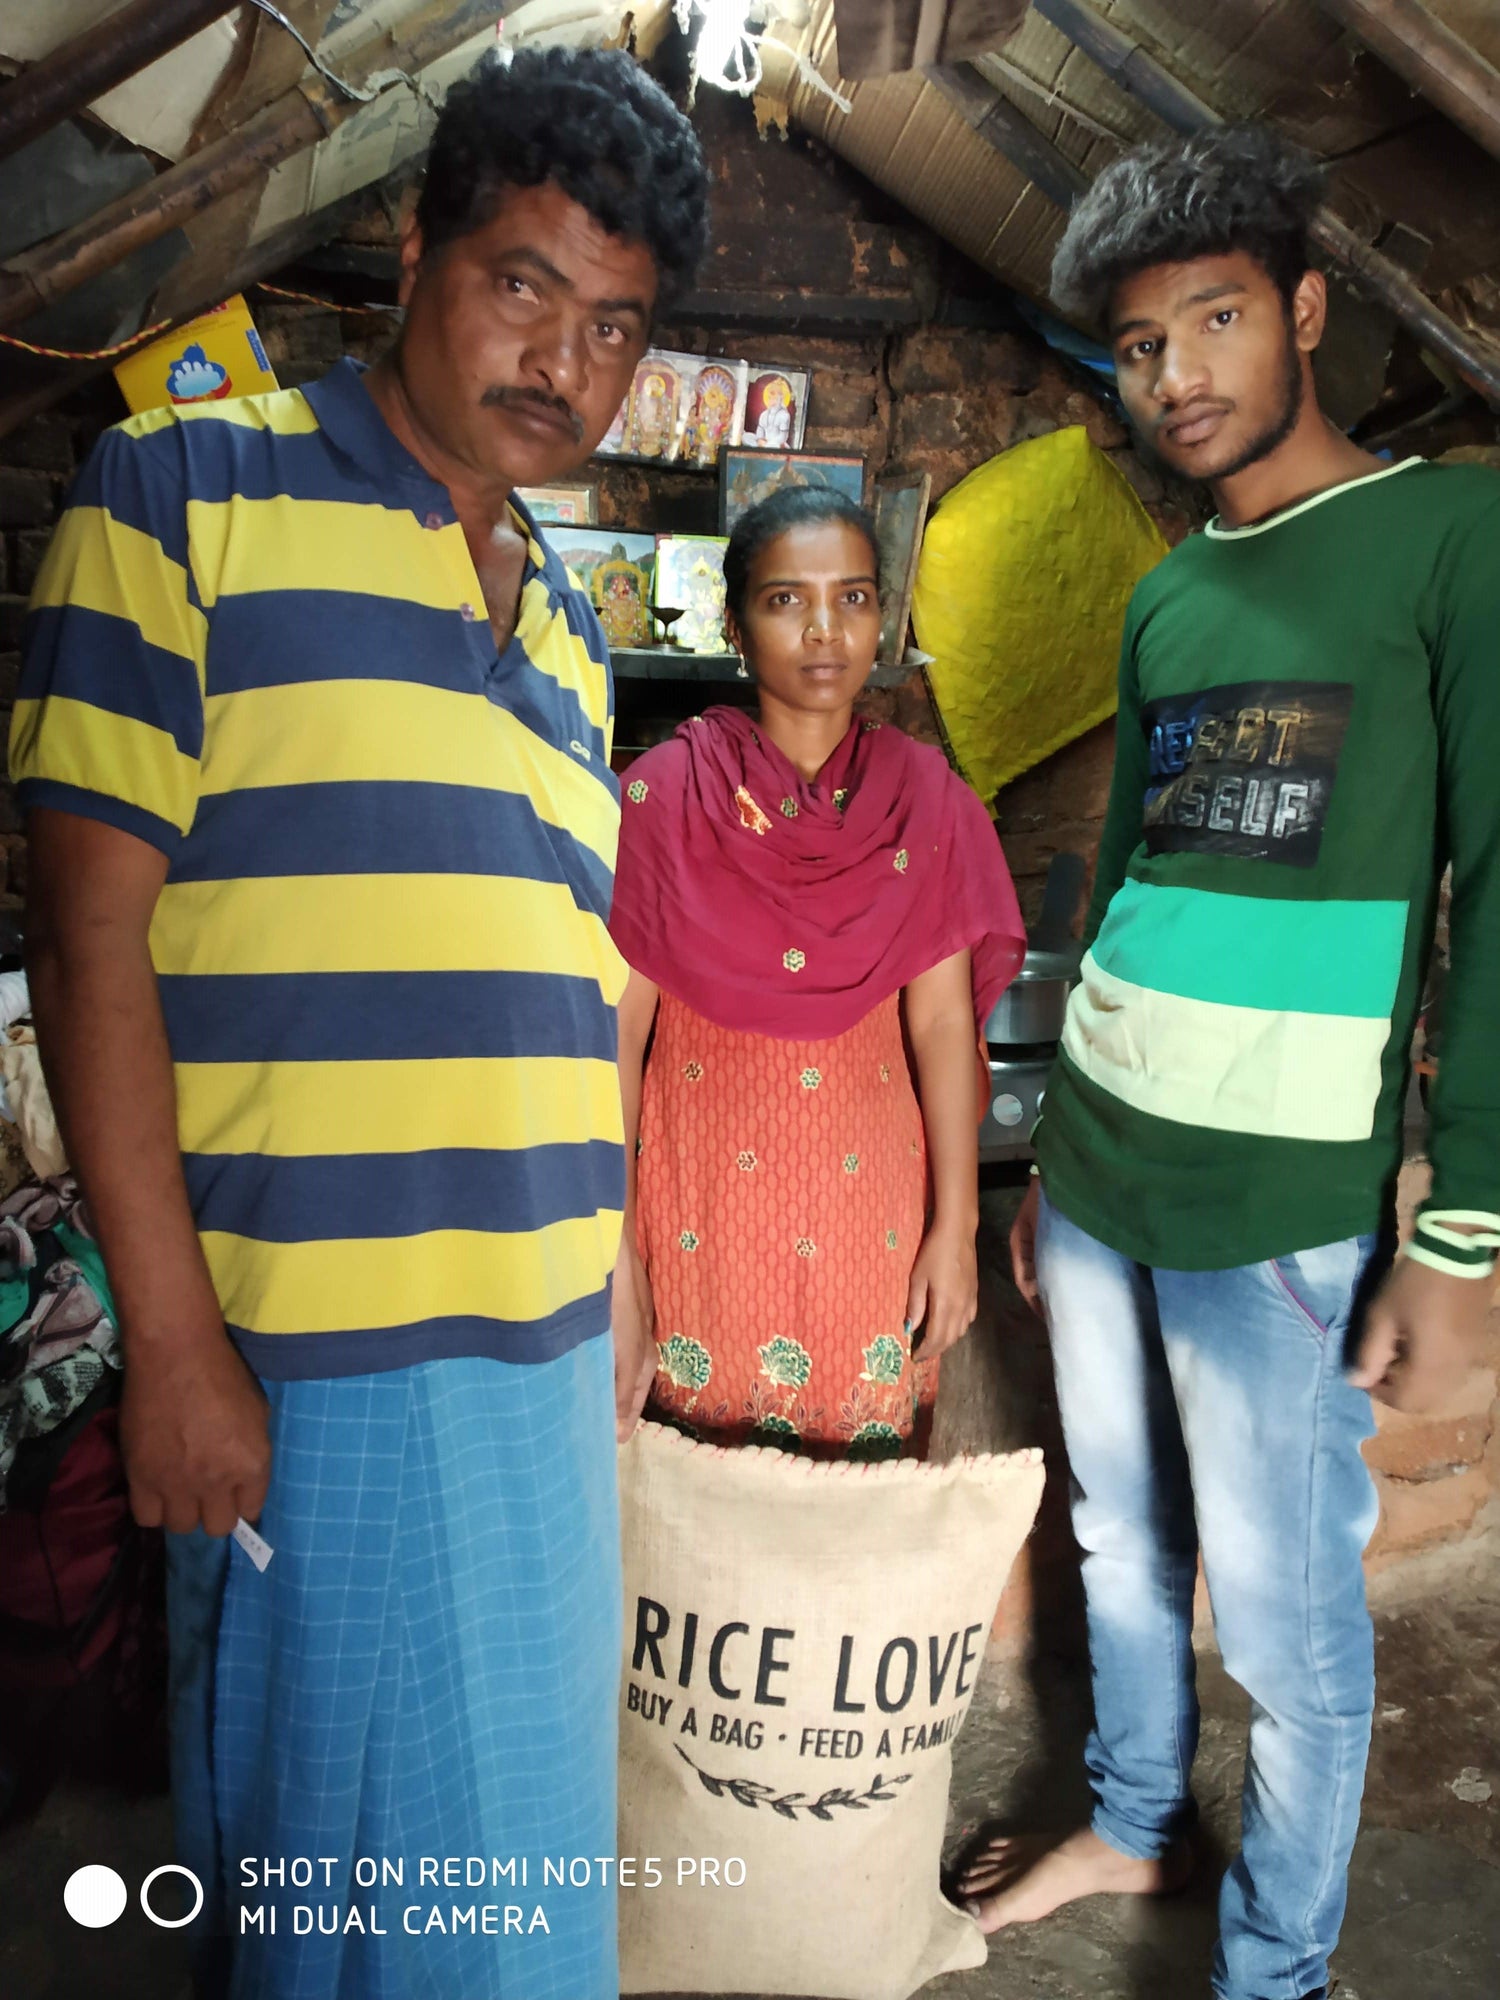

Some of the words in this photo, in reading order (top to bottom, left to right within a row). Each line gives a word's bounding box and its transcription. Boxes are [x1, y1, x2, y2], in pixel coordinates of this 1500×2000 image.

[631, 1595, 796, 1708] RICE
[833, 1622, 983, 1714] LOVE
[626, 1681, 674, 1727] BUY
[680, 1707, 698, 1738] A
[709, 1713, 765, 1751] BAG
[799, 1728, 864, 1759] FEED
[875, 1729, 892, 1758] A
